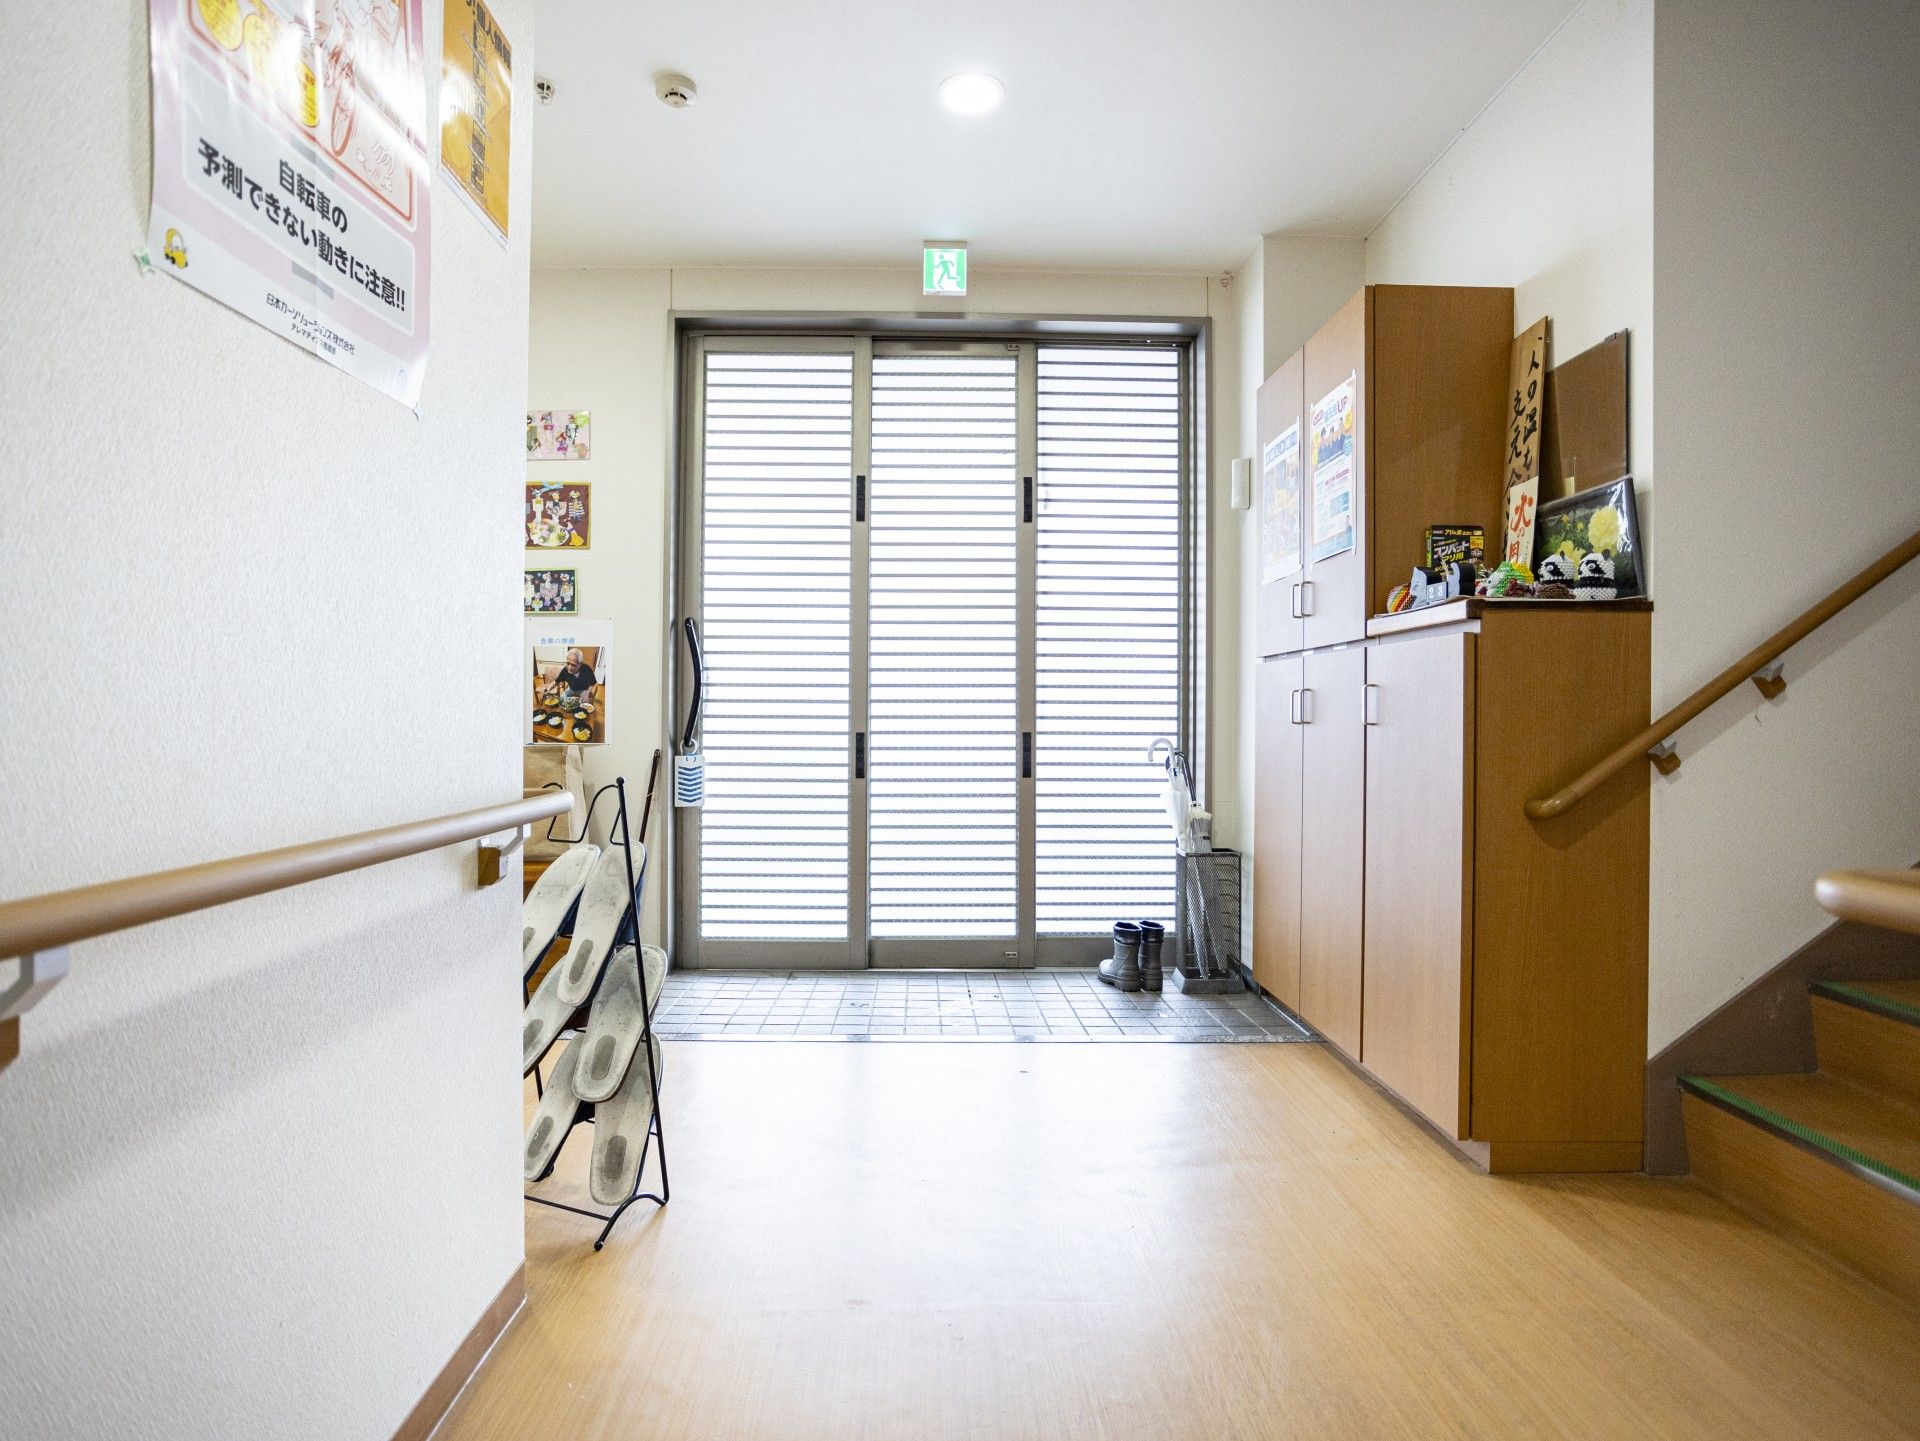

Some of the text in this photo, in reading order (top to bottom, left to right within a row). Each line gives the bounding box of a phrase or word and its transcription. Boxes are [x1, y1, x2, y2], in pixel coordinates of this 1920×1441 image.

[198, 136, 406, 312] 予測できない動きに注意!!
[279, 159, 348, 233] 自転車の
